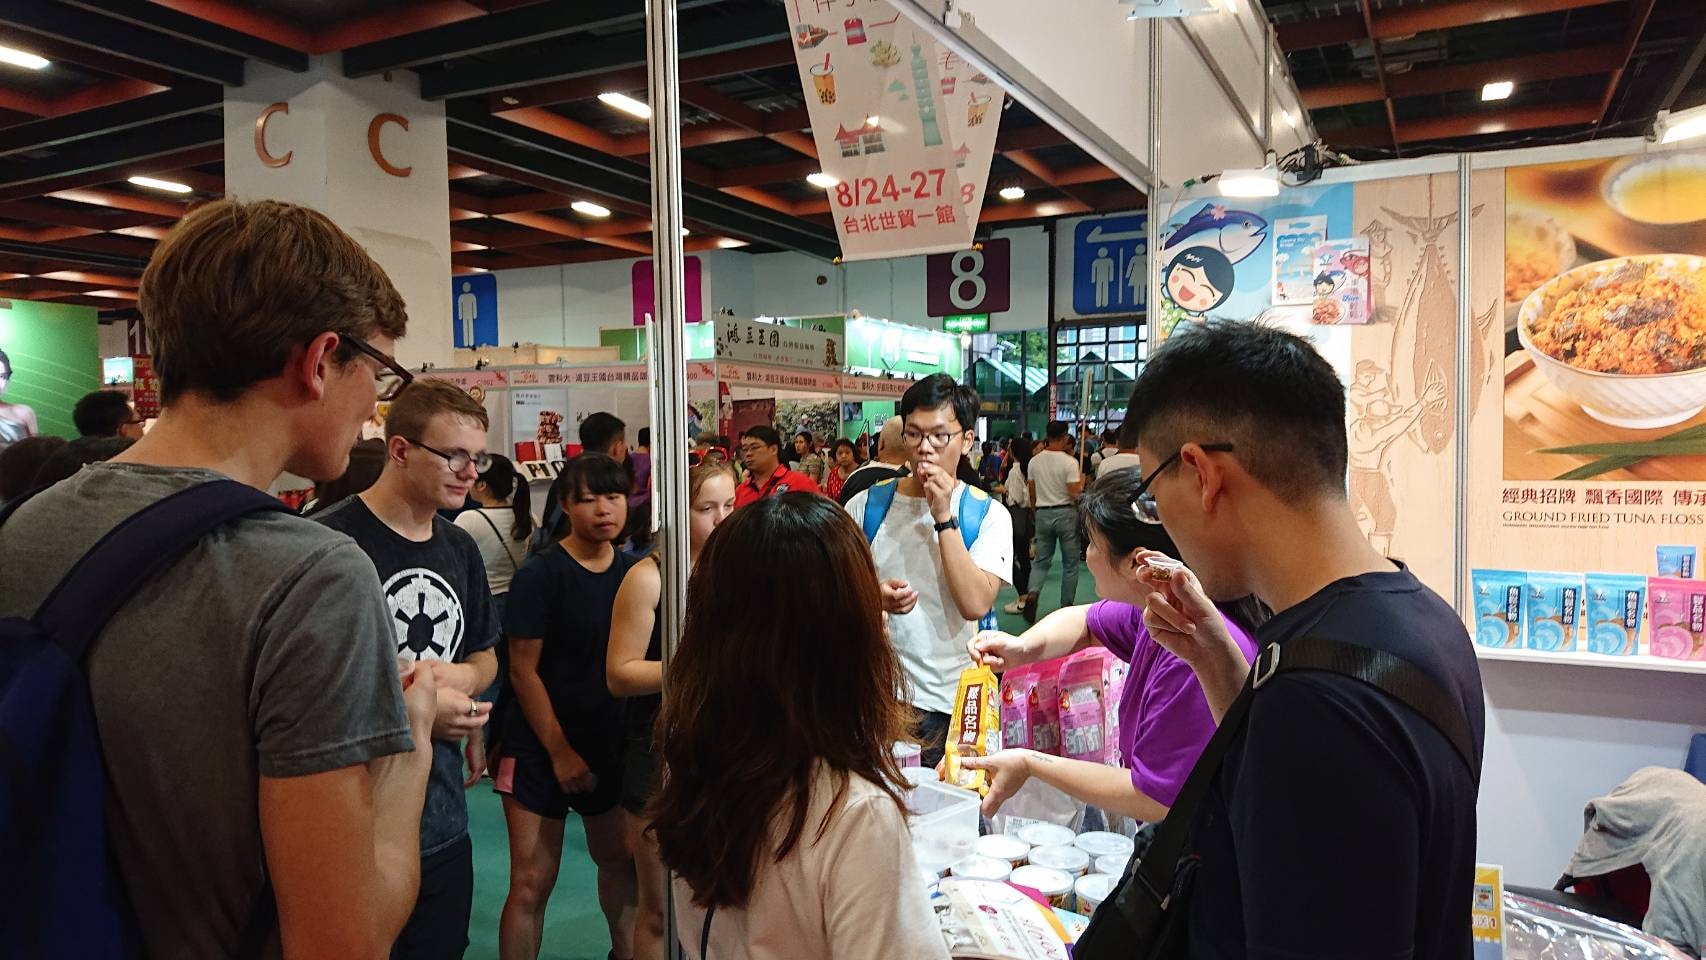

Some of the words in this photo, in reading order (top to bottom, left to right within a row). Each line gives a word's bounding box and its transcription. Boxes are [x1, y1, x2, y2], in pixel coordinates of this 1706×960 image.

[256, 102, 293, 168] C
[367, 113, 413, 177] C
[835, 169, 946, 209] 8/24-27
[844, 204, 955, 235] 台北世貿一館
[950, 250, 986, 310] 8
[1502, 487, 1576, 506] 經典招牌
[1585, 488, 1663, 506] 飄香國際
[1502, 511, 1566, 523] GROUND
[1570, 512, 1610, 523] FRIED
[1614, 512, 1655, 525] TUNA
[1661, 513, 1705, 526] FLOSS
